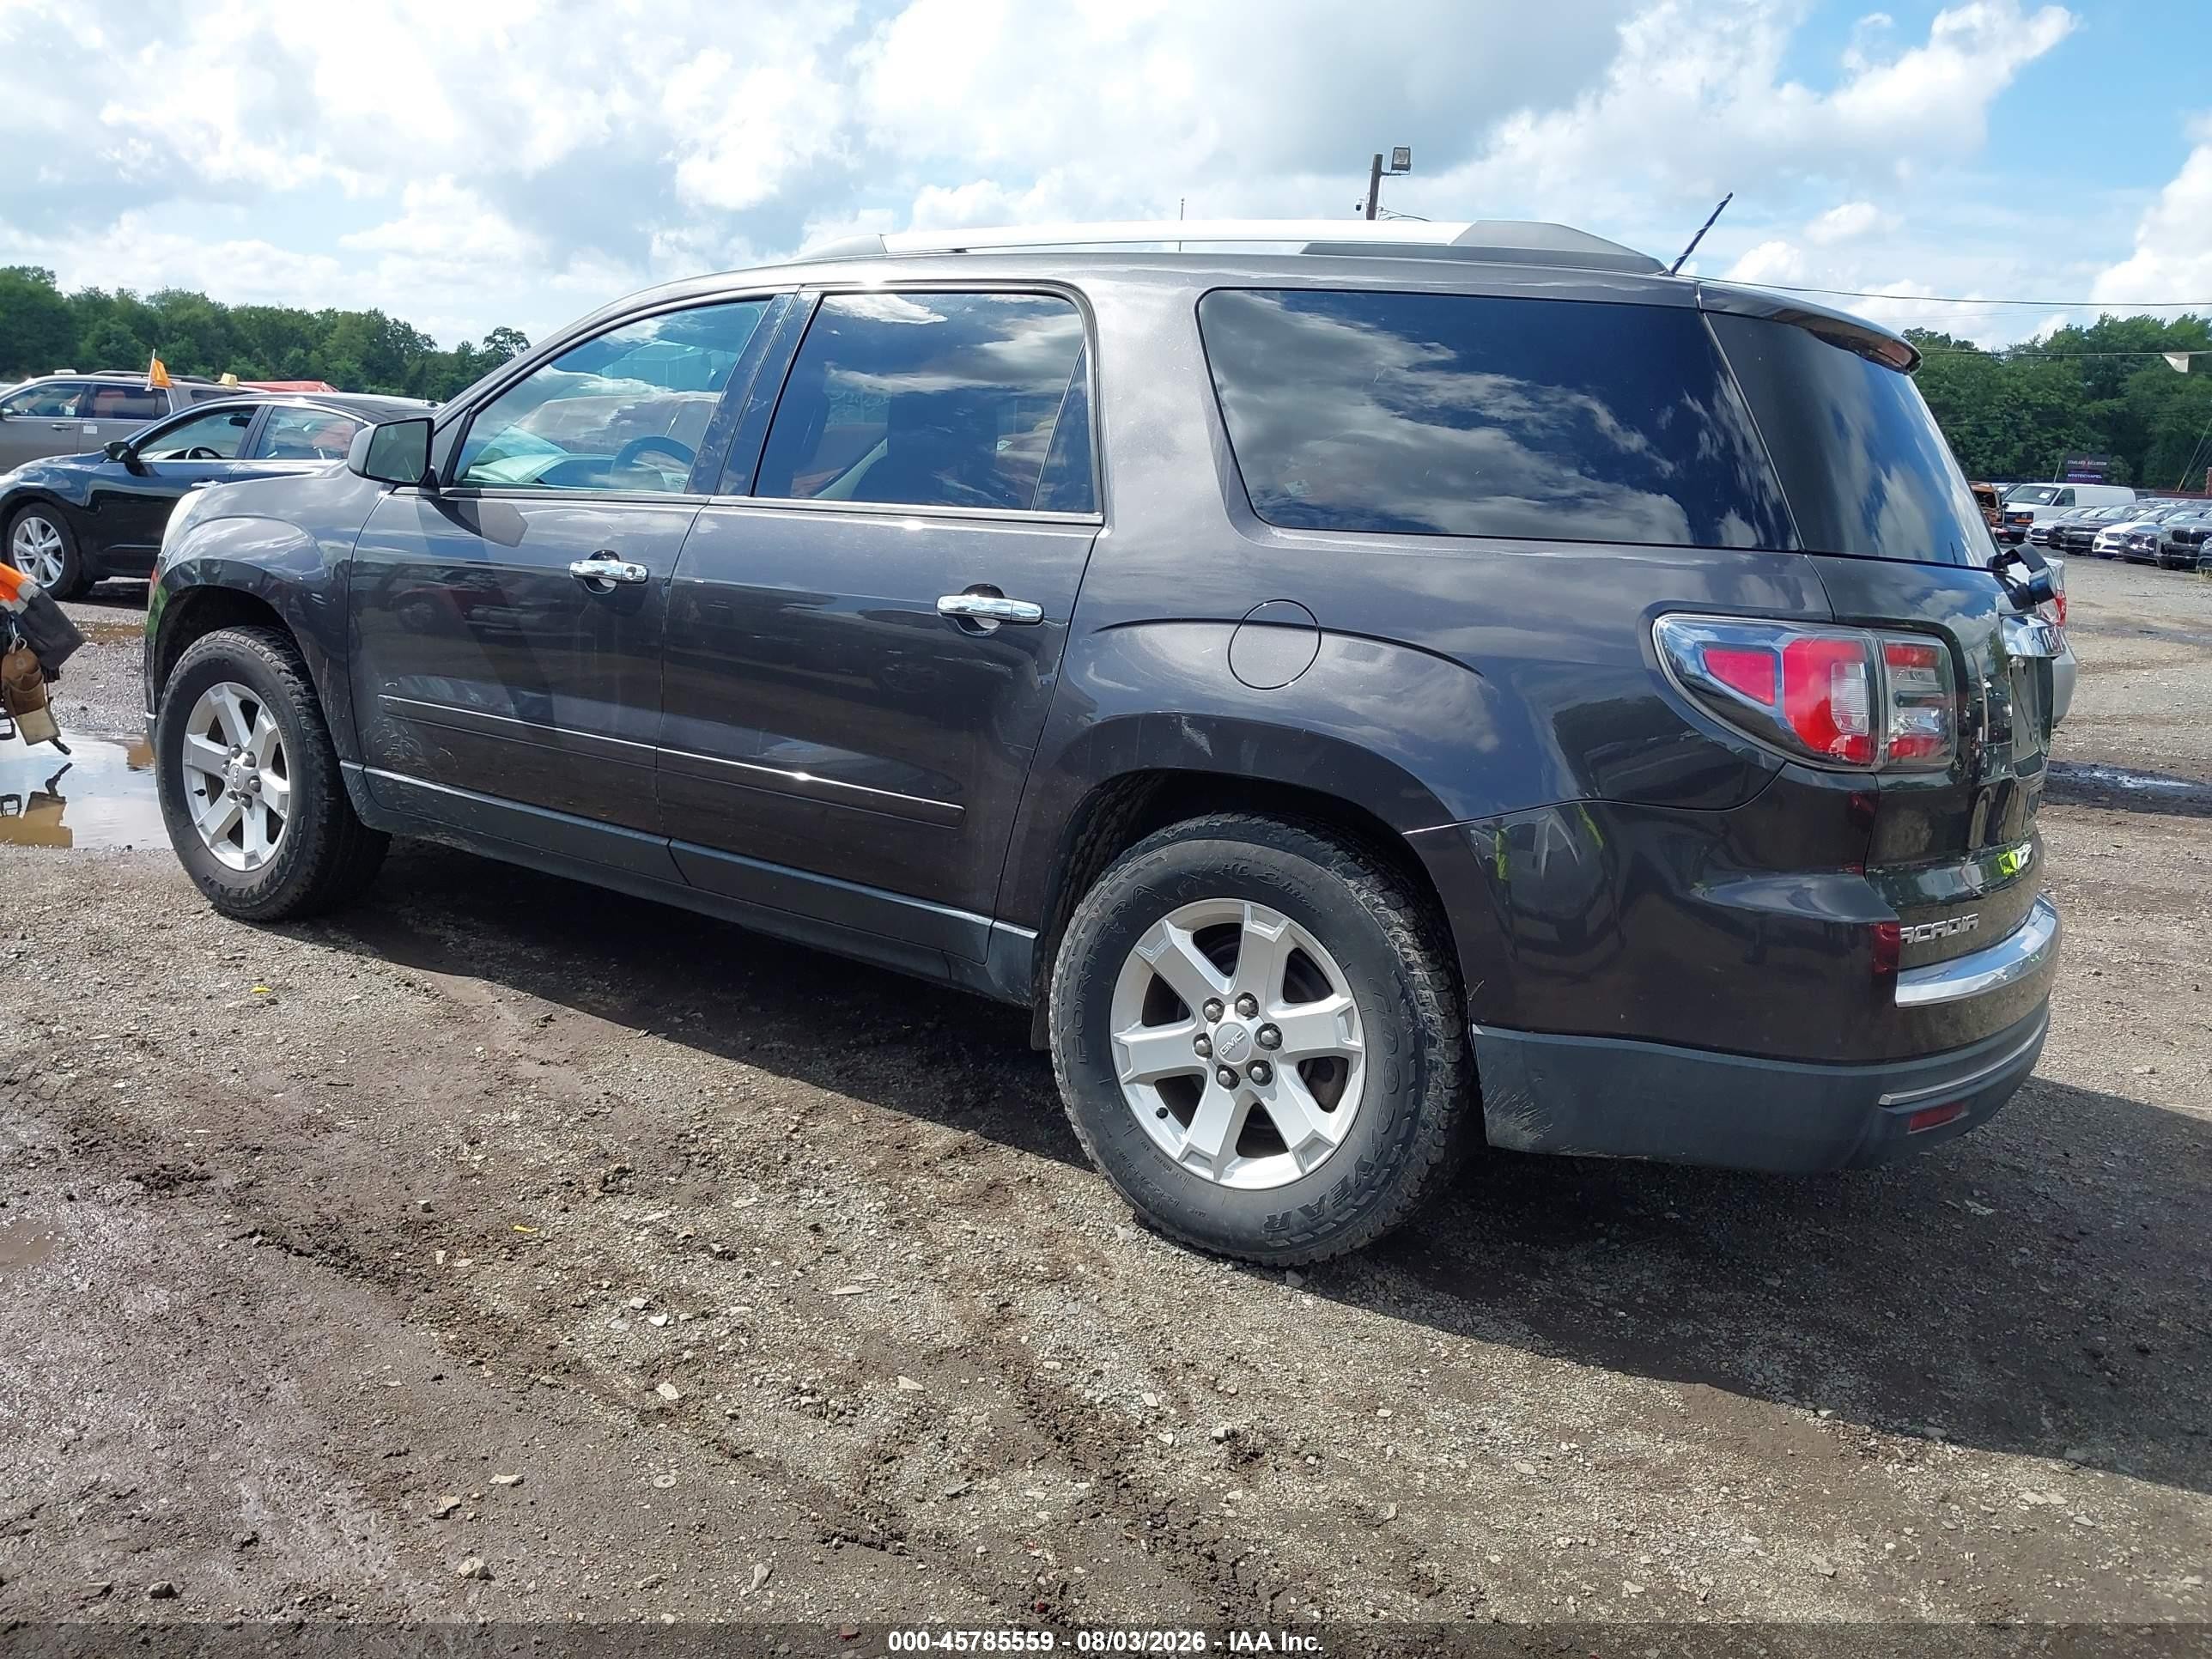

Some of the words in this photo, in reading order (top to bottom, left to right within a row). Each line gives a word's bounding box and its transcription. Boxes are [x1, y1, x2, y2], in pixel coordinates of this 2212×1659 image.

[1899, 913, 1978, 944] ACADIA
[1072, 882, 1158, 1065] FORTERA
[1219, 1030, 1245, 1055] GMC
